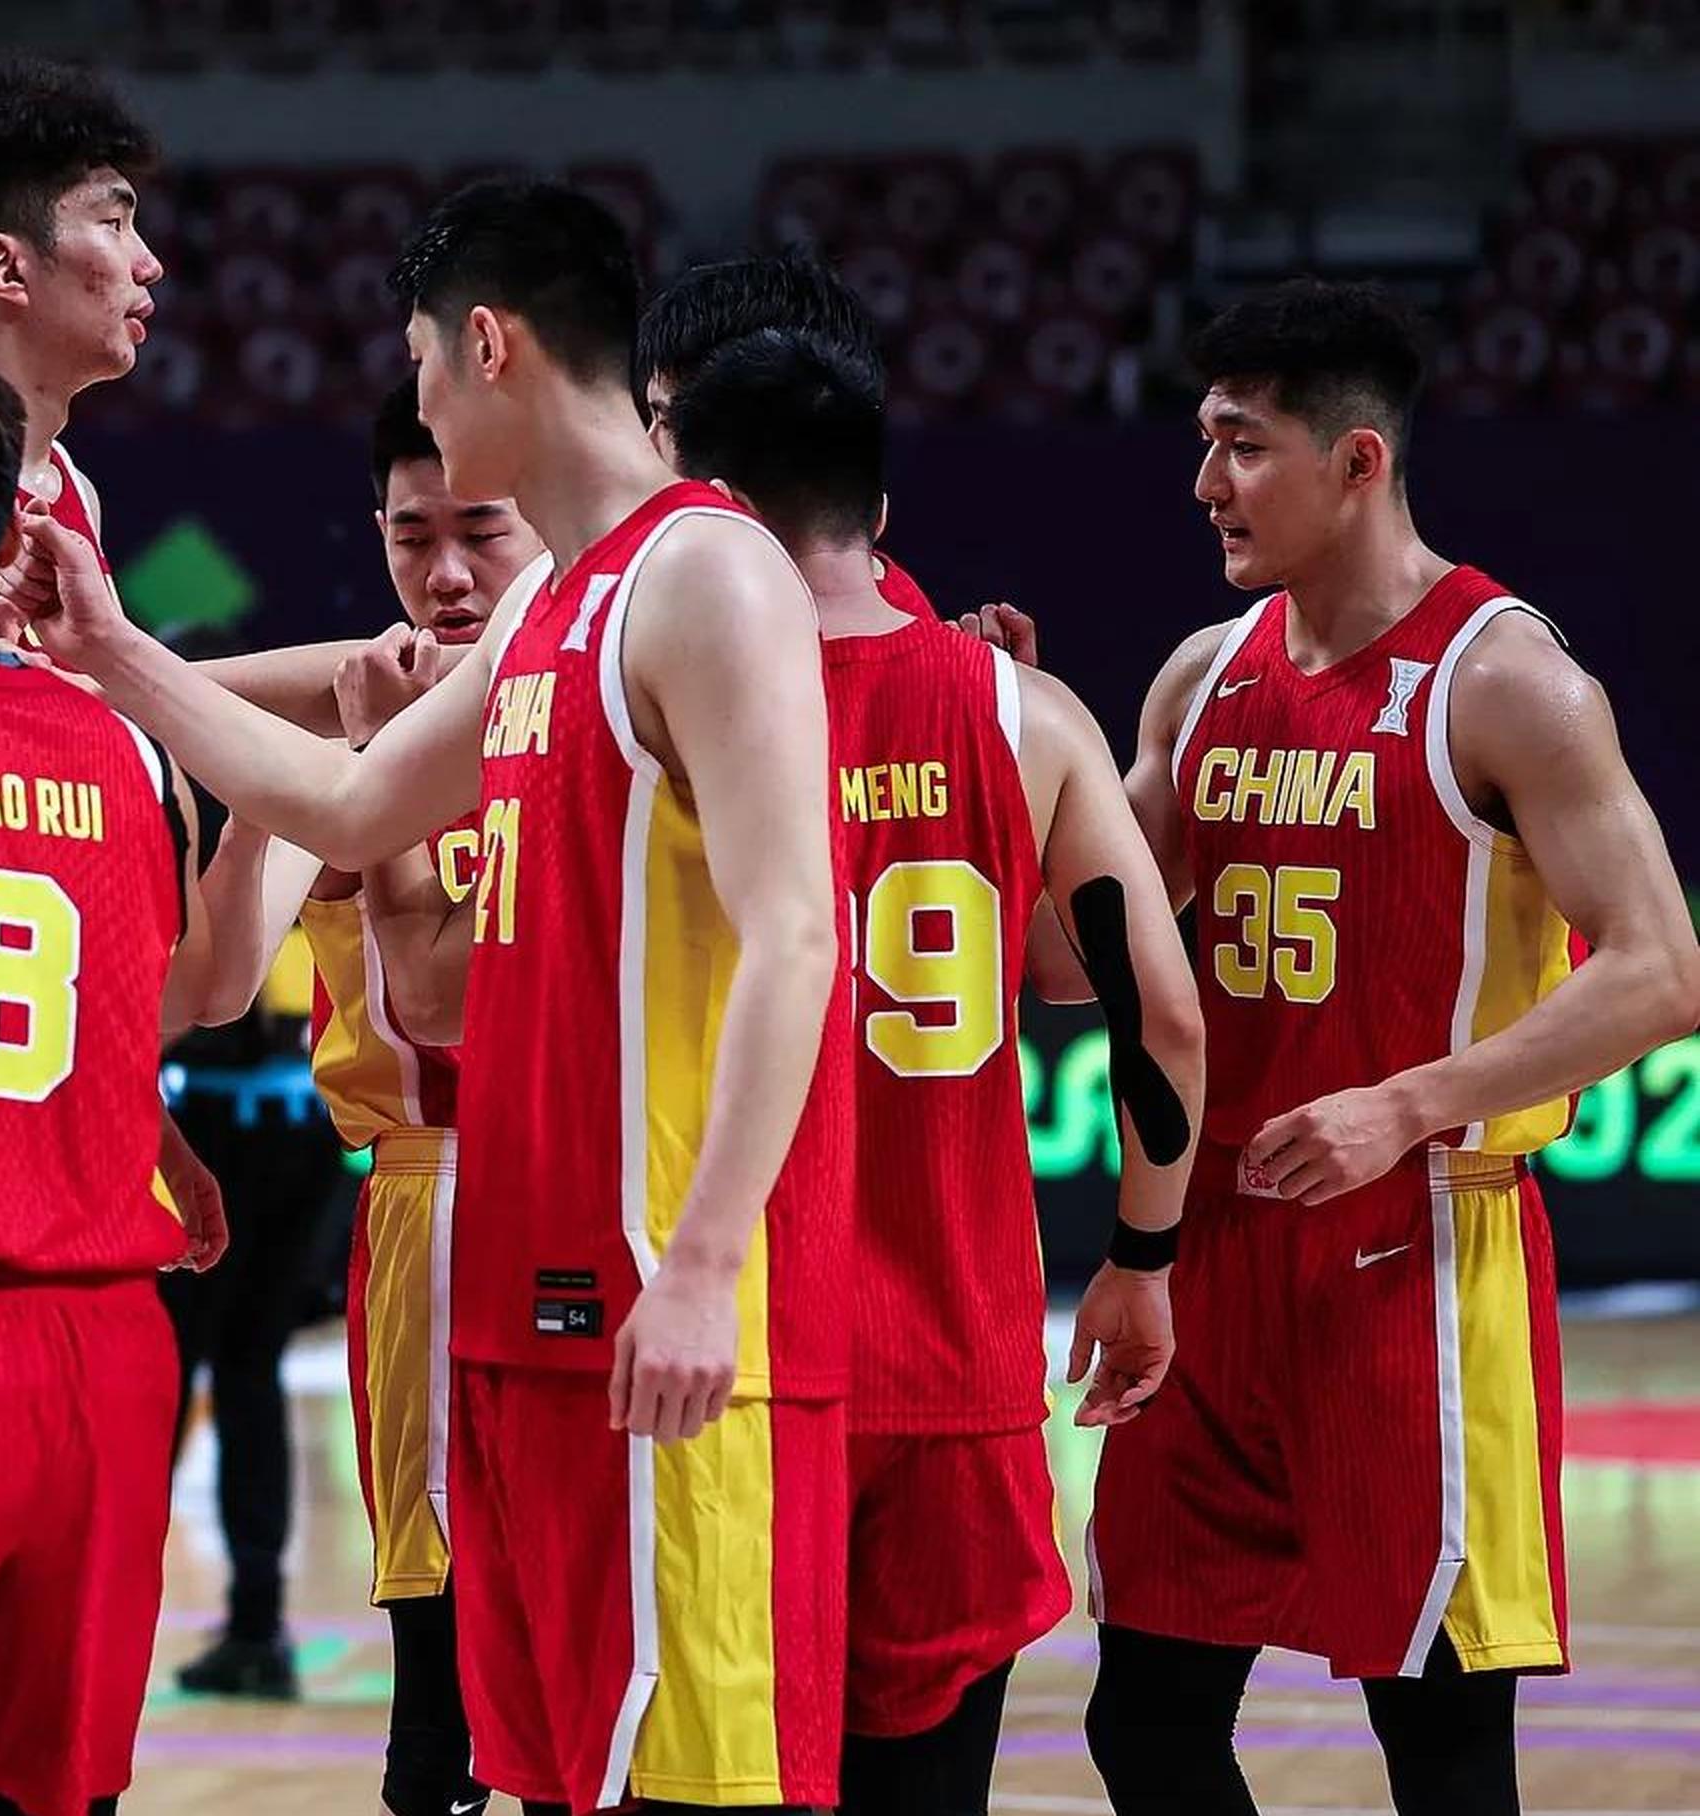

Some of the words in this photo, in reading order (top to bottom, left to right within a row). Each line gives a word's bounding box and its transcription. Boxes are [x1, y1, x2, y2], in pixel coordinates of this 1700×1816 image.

[35, 777, 103, 842] RUI
[839, 762, 948, 822] MENG
[1194, 747, 1376, 829] CHINA
[849, 860, 1004, 1076] 9
[1214, 864, 1341, 1004] 35
